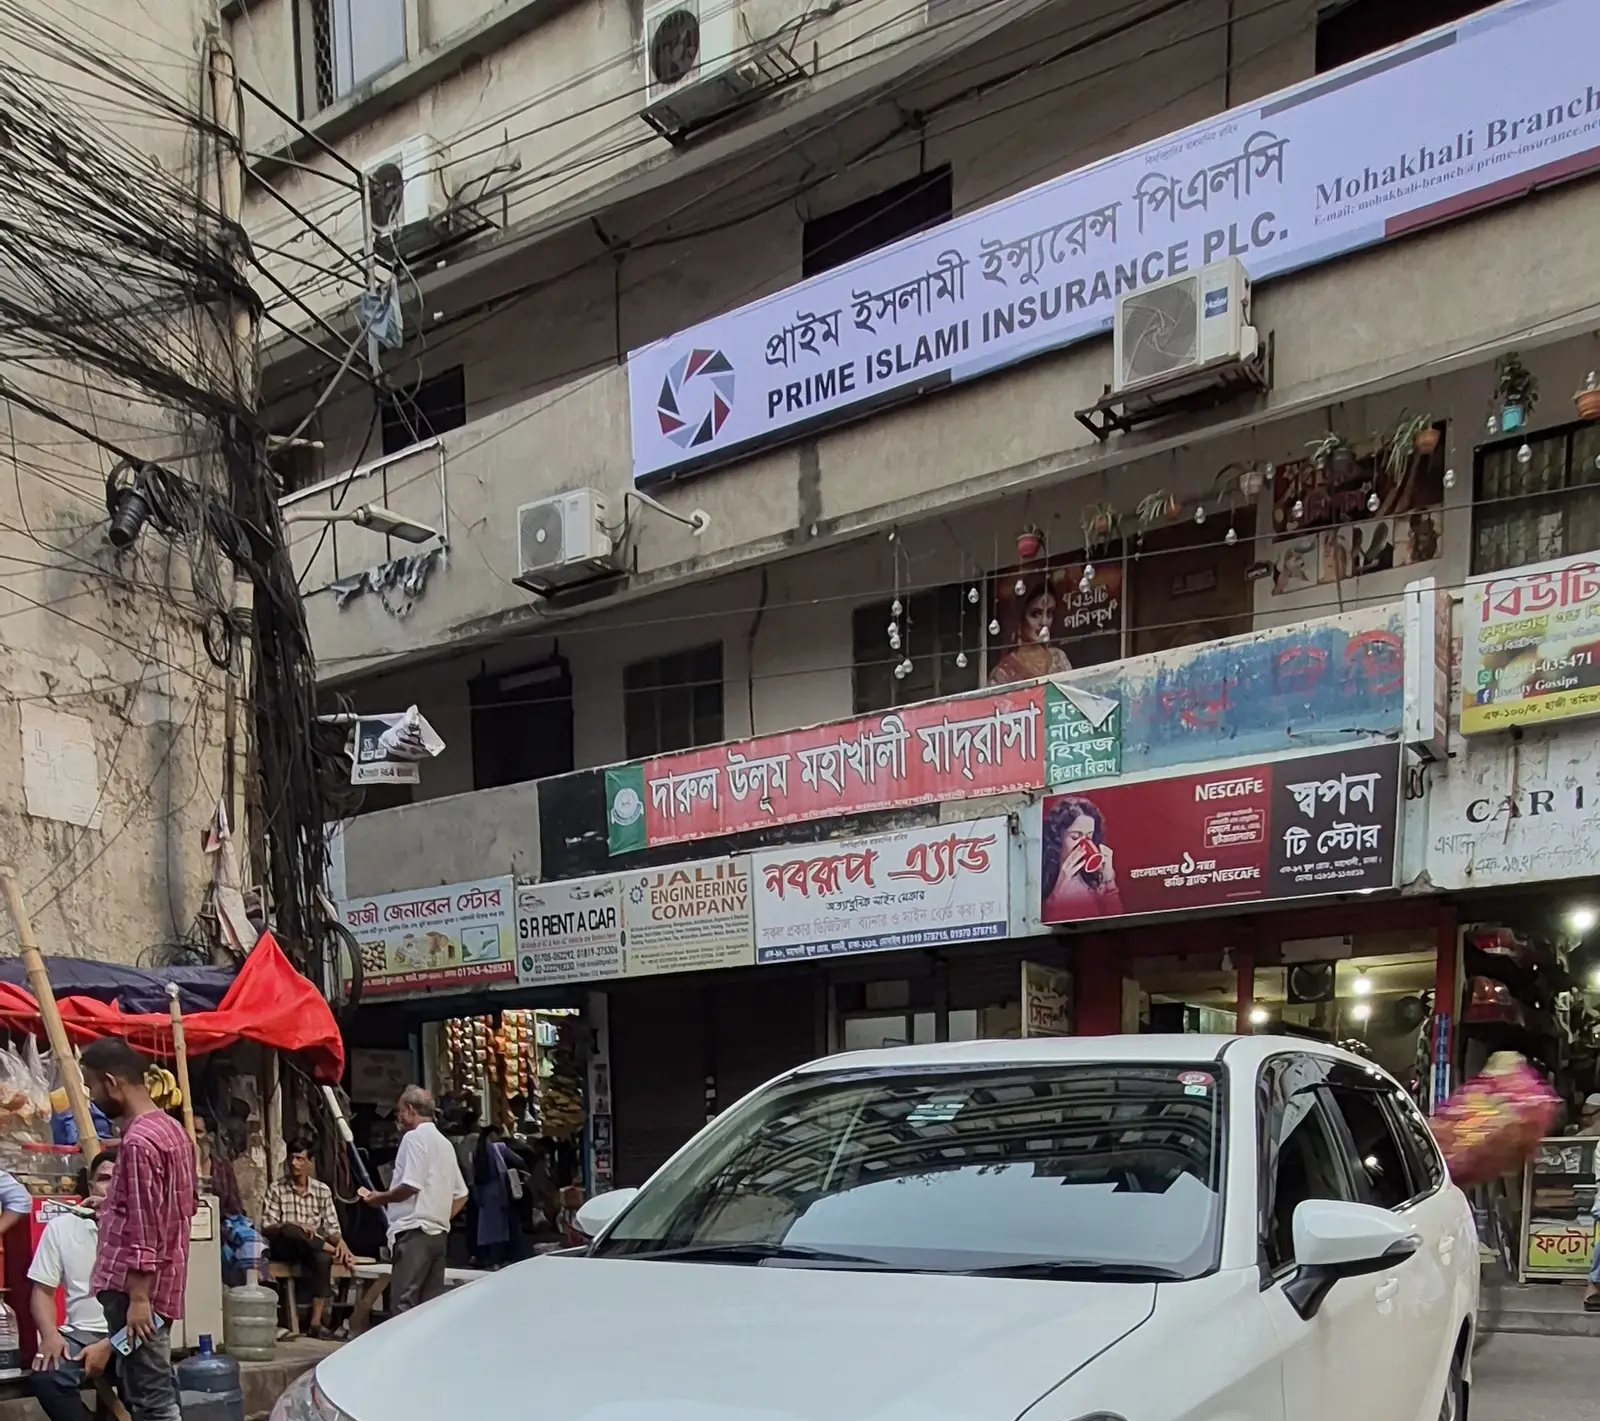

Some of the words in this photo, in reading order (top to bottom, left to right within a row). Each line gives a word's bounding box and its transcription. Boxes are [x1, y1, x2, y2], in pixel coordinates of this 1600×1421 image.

[1315, 129, 1474, 210] Mohakhali
[1484, 85, 1600, 150] Branch
[765, 308, 843, 368] প্রাইম
[850, 249, 970, 336] ইসলামী
[979, 201, 1122, 285] ইন্স্যুরেন্স
[1132, 130, 1290, 235] পিএলসি
[767, 361, 856, 419] PRIME
[866, 319, 969, 384] ISLAMI
[982, 240, 1189, 344] INSURANCE
[1203, 211, 1288, 265] PLC.
[1535, 675, 1578, 691] Gossips
[649, 768, 720, 818] দারুল
[725, 750, 792, 815] উলূম
[797, 714, 912, 796] মহাখালী
[1050, 763, 1083, 782] কিতাব
[1085, 757, 1116, 776] বিভাগ
[1285, 772, 1382, 818] স্বপন
[1466, 789, 1556, 823] CAR
[1282, 826, 1312, 858] টি
[1317, 820, 1382, 854] স্টোর
[650, 862, 748, 889] JALIL
[651, 878, 748, 905] ENGINEERING
[762, 848, 879, 900] নবরূপ
[347, 902, 379, 927] হাজী
[384, 896, 451, 921] জেনারেল
[457, 888, 500, 912] স্টোর
[542, 911, 575, 937] RENT
[577, 910, 587, 932] A
[588, 907, 616, 930] CAR
[652, 895, 748, 921] COMPANY
[1535, 1227, 1590, 1256] ফটো
